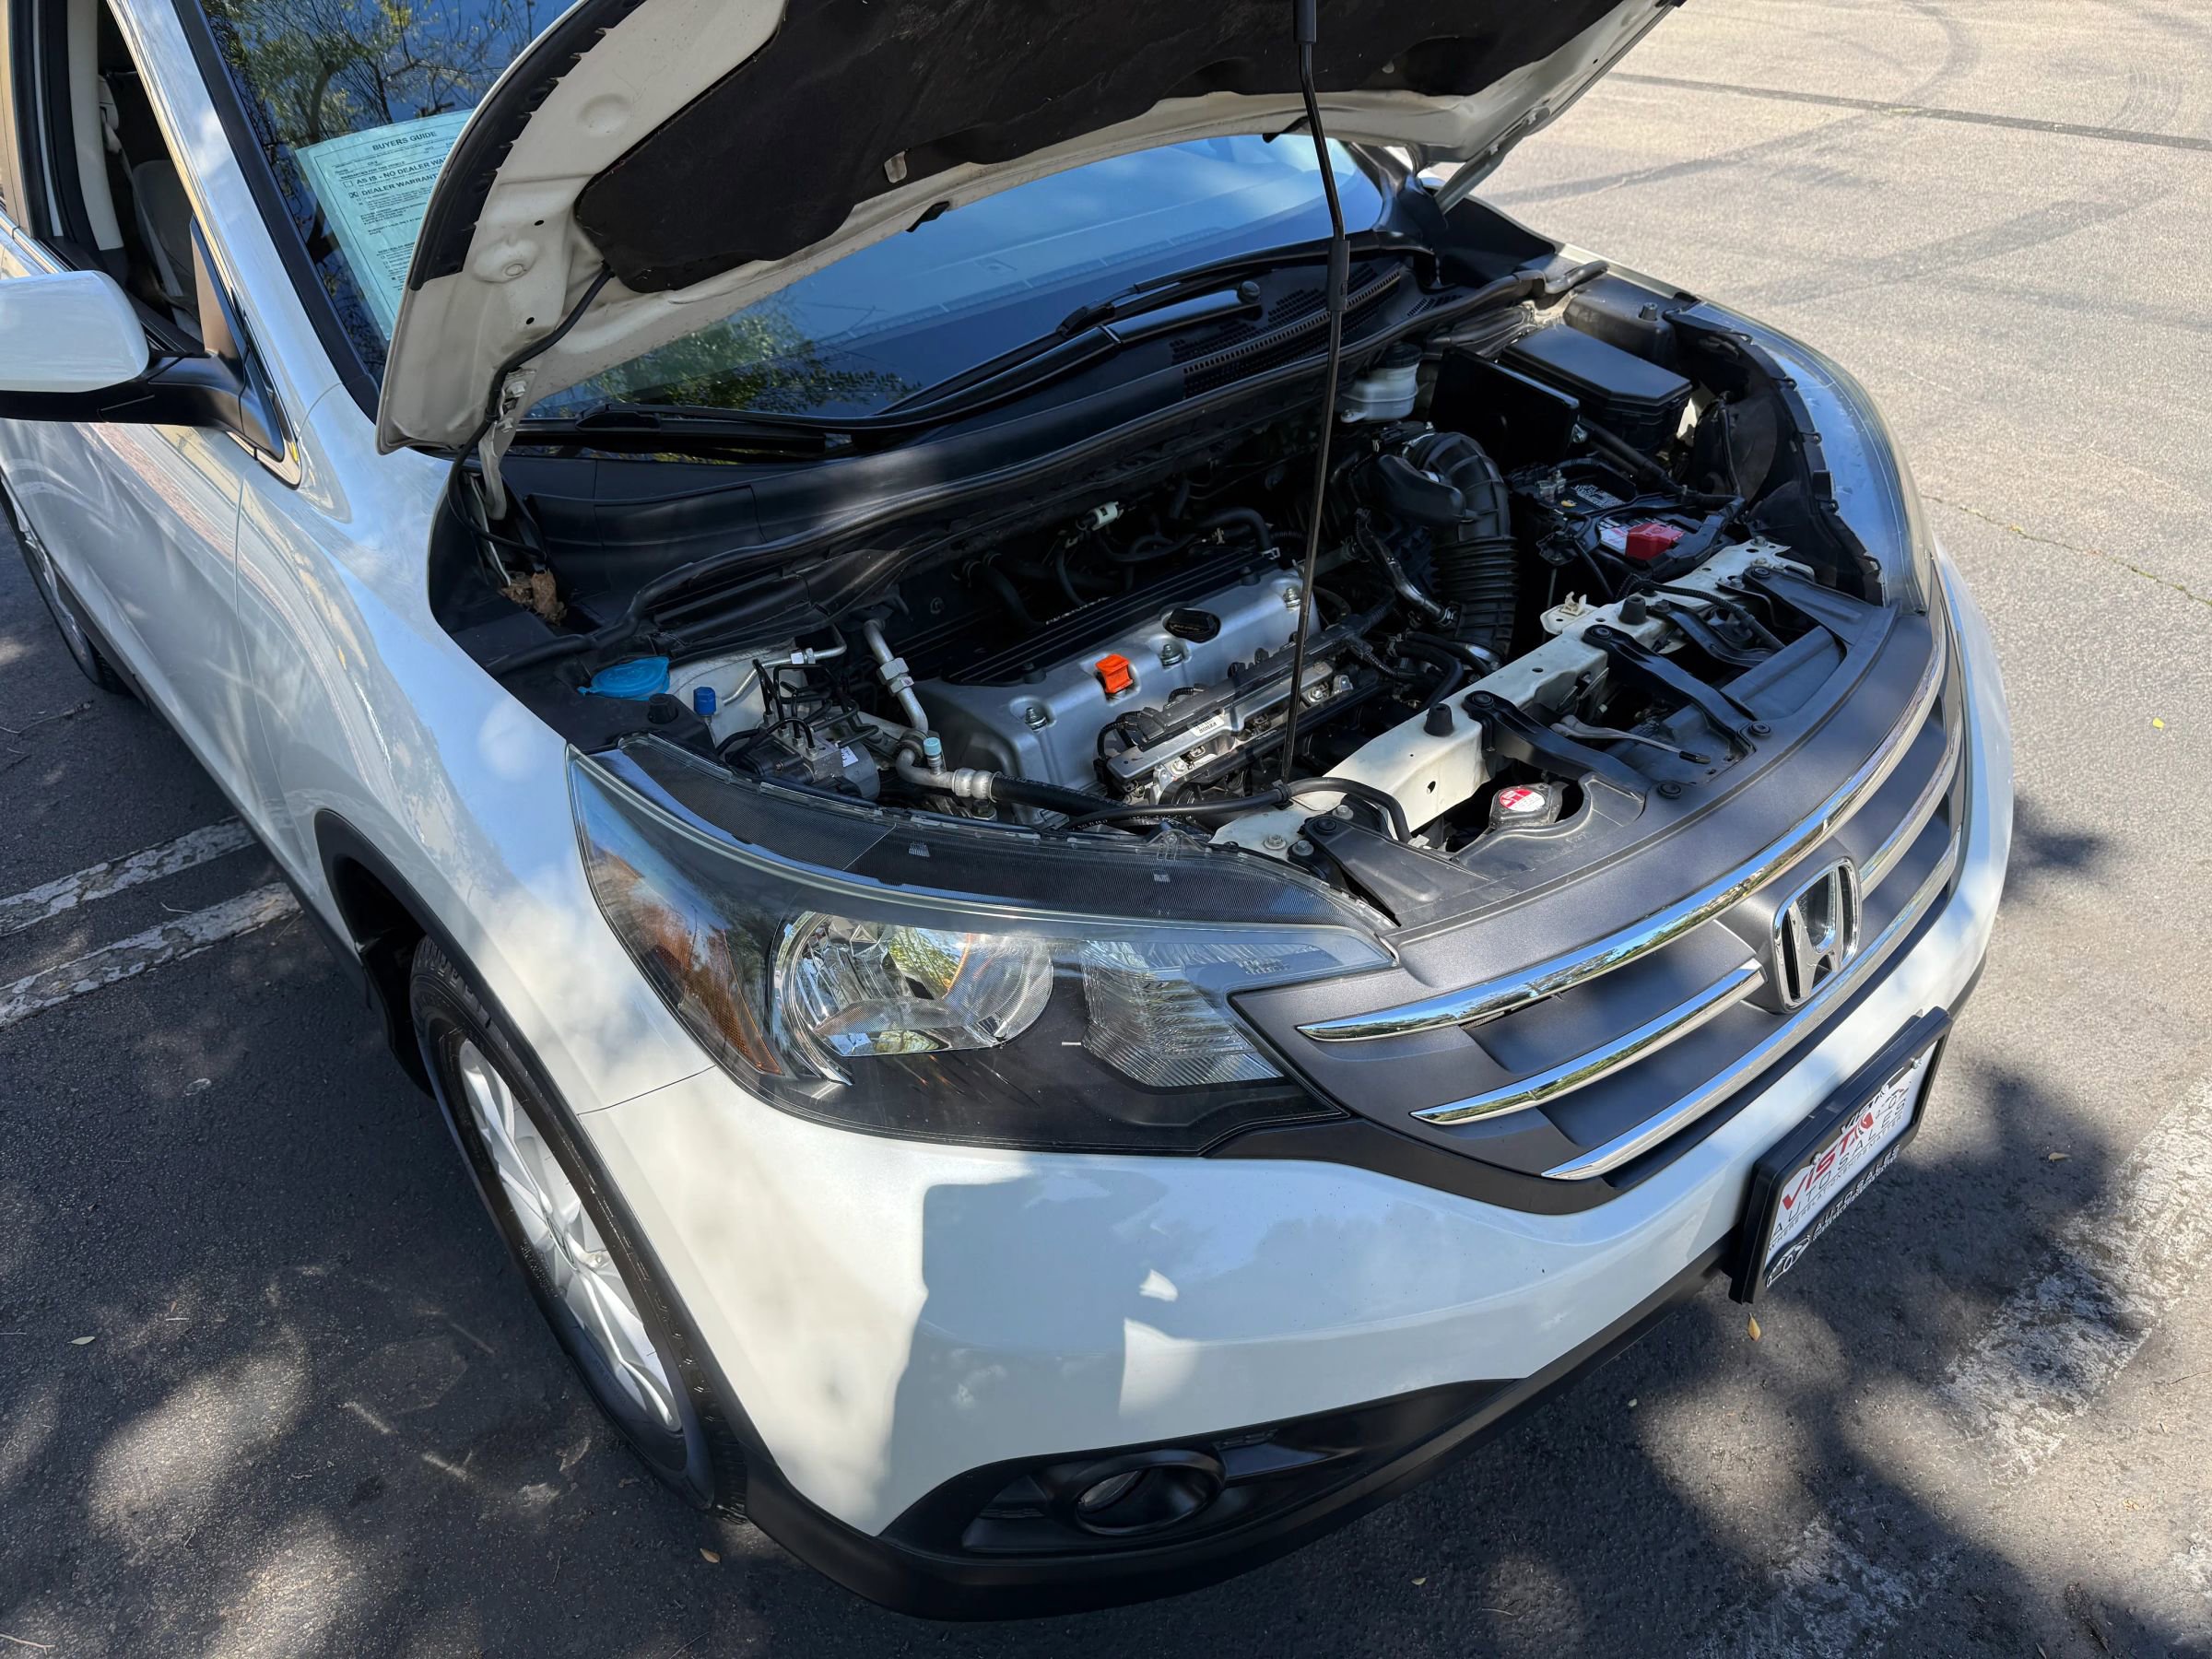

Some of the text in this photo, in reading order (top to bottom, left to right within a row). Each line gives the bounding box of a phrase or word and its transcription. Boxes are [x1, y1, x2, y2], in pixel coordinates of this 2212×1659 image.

[372, 131, 437, 151] BUYERS GUIDE
[357, 177, 368, 185] AS
[397, 162, 429, 174] DEALER
[429, 157, 446, 166] WA
[361, 183, 395, 196] DEALER
[1771, 1170, 1831, 1242] AUTO
[1838, 1098, 1906, 1172] SALES
